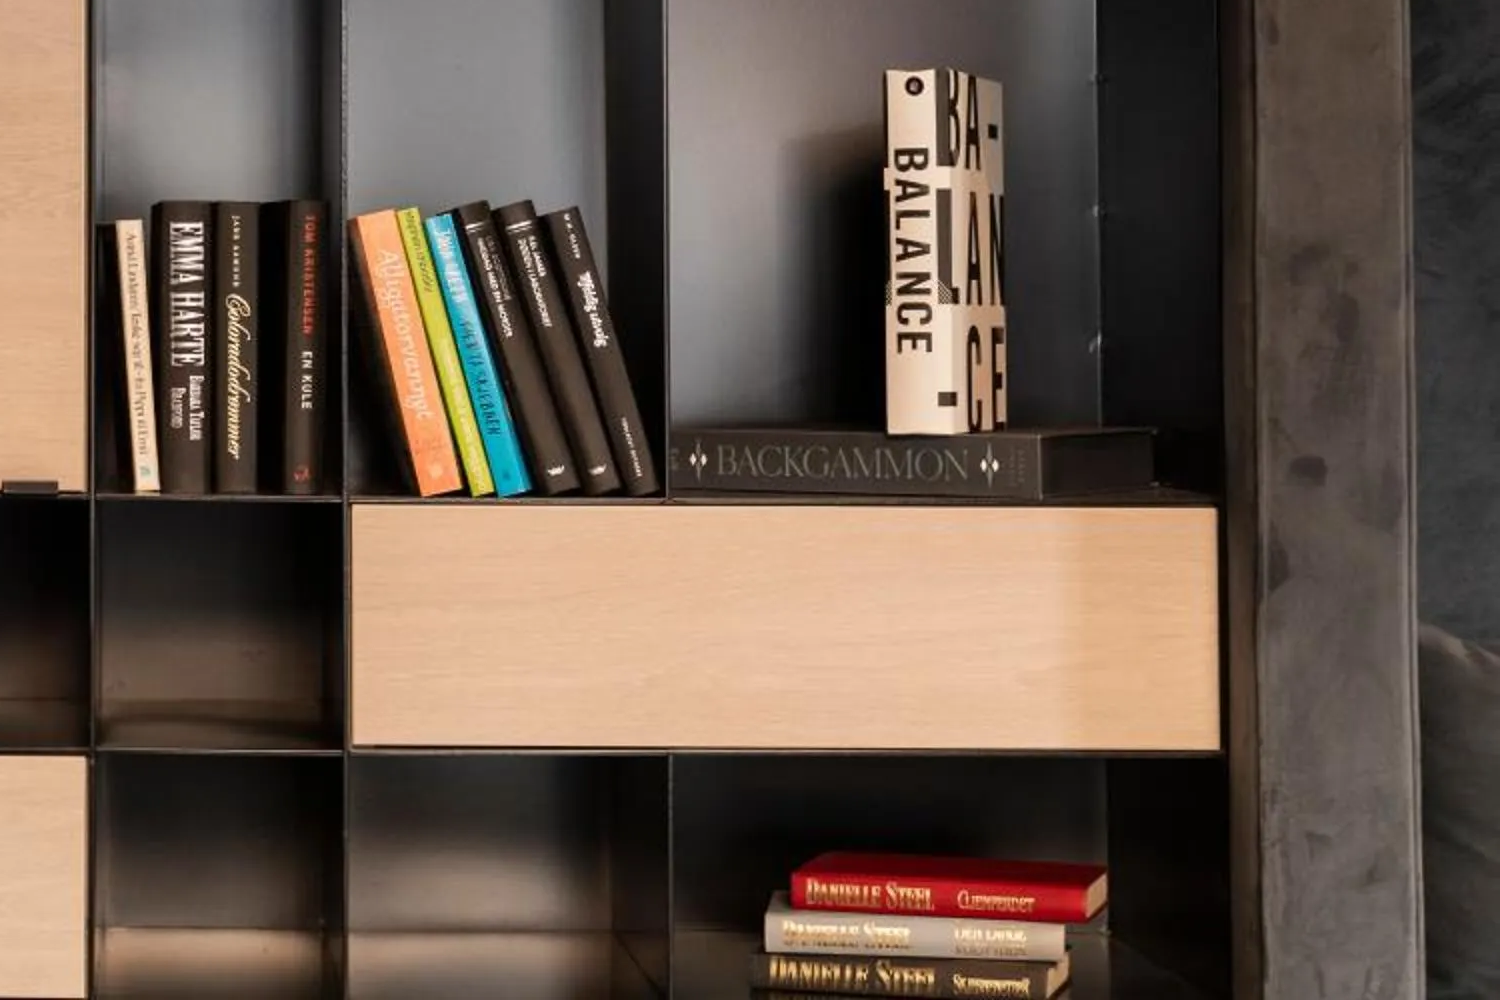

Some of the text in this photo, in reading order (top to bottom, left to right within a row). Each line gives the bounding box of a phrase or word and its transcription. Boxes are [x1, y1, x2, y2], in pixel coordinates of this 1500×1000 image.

[169, 221, 205, 367] EMMA HARTE
[893, 147, 933, 355] BALANCE
[301, 375, 313, 409] KULE
[716, 444, 969, 484] BACKGAMMON
